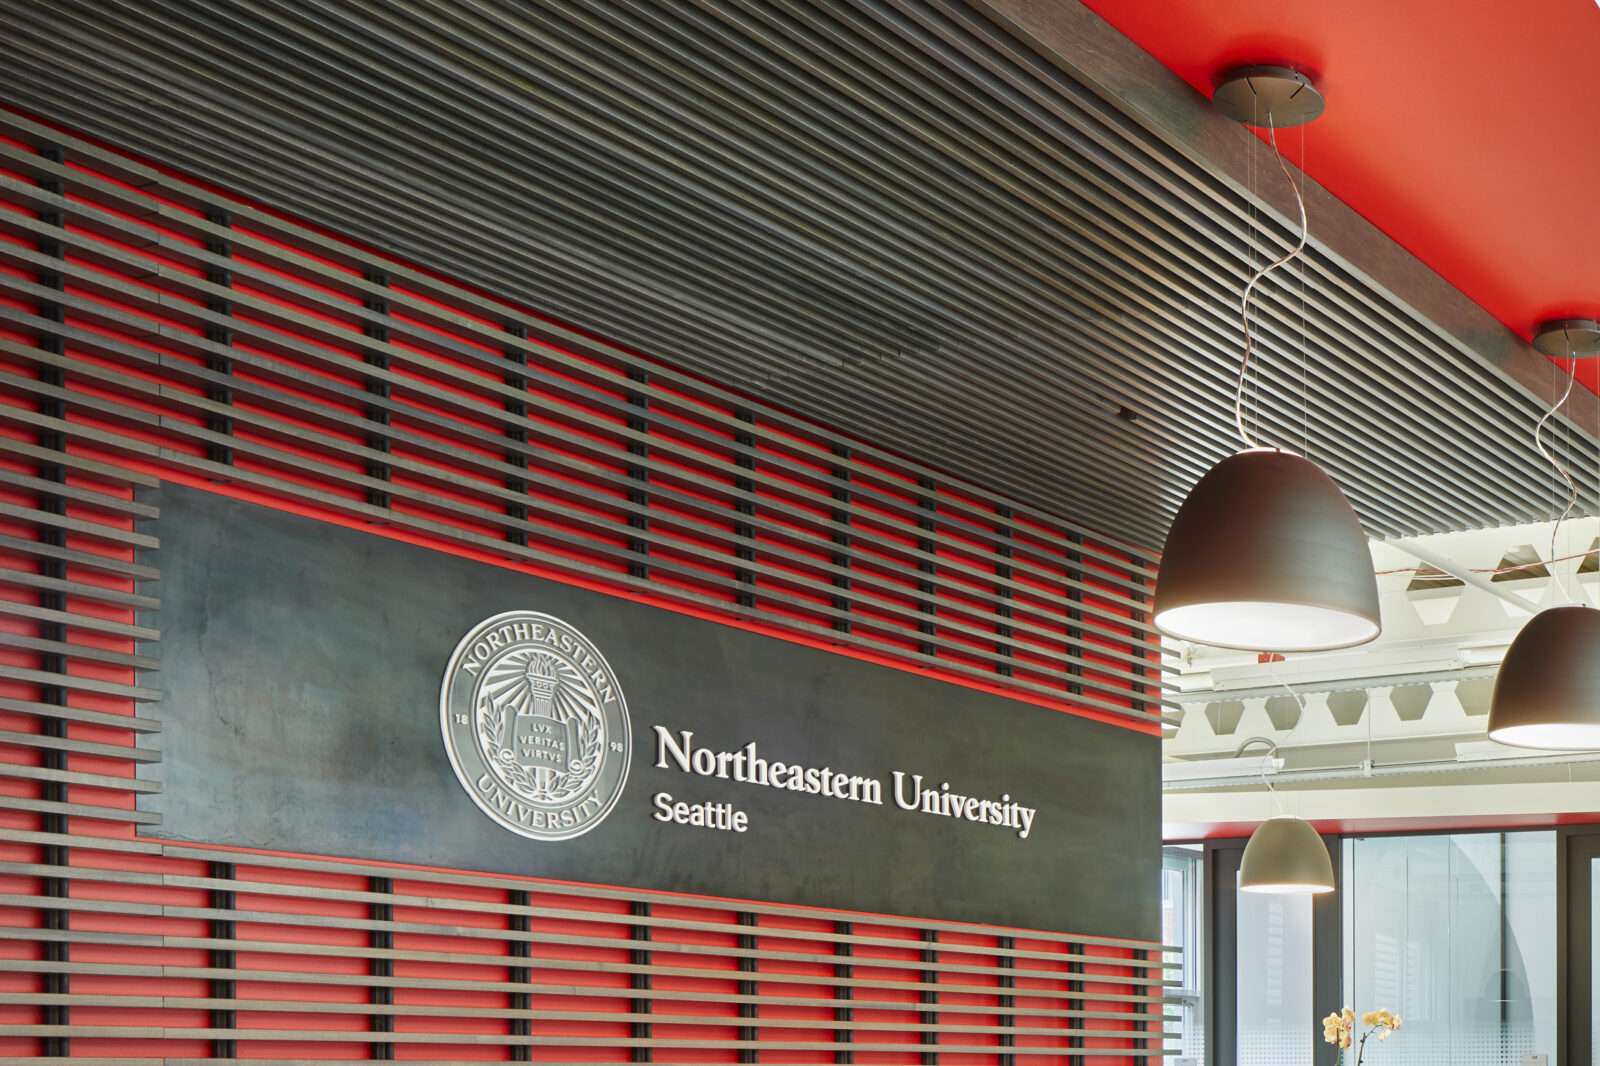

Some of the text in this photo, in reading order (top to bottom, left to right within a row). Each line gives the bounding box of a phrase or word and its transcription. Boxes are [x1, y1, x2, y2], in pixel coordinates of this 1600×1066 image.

[462, 623, 617, 704] NORTHEASTERN
[453, 713, 469, 725] 18
[531, 722, 552, 735] LVX
[519, 735, 565, 751] VERITAS
[610, 741, 624, 753] 98
[521, 748, 562, 763] VIRTVS
[652, 725, 1037, 839] Northeastern University
[477, 773, 604, 829] UNIVERSITY
[653, 792, 749, 833] Seattle
